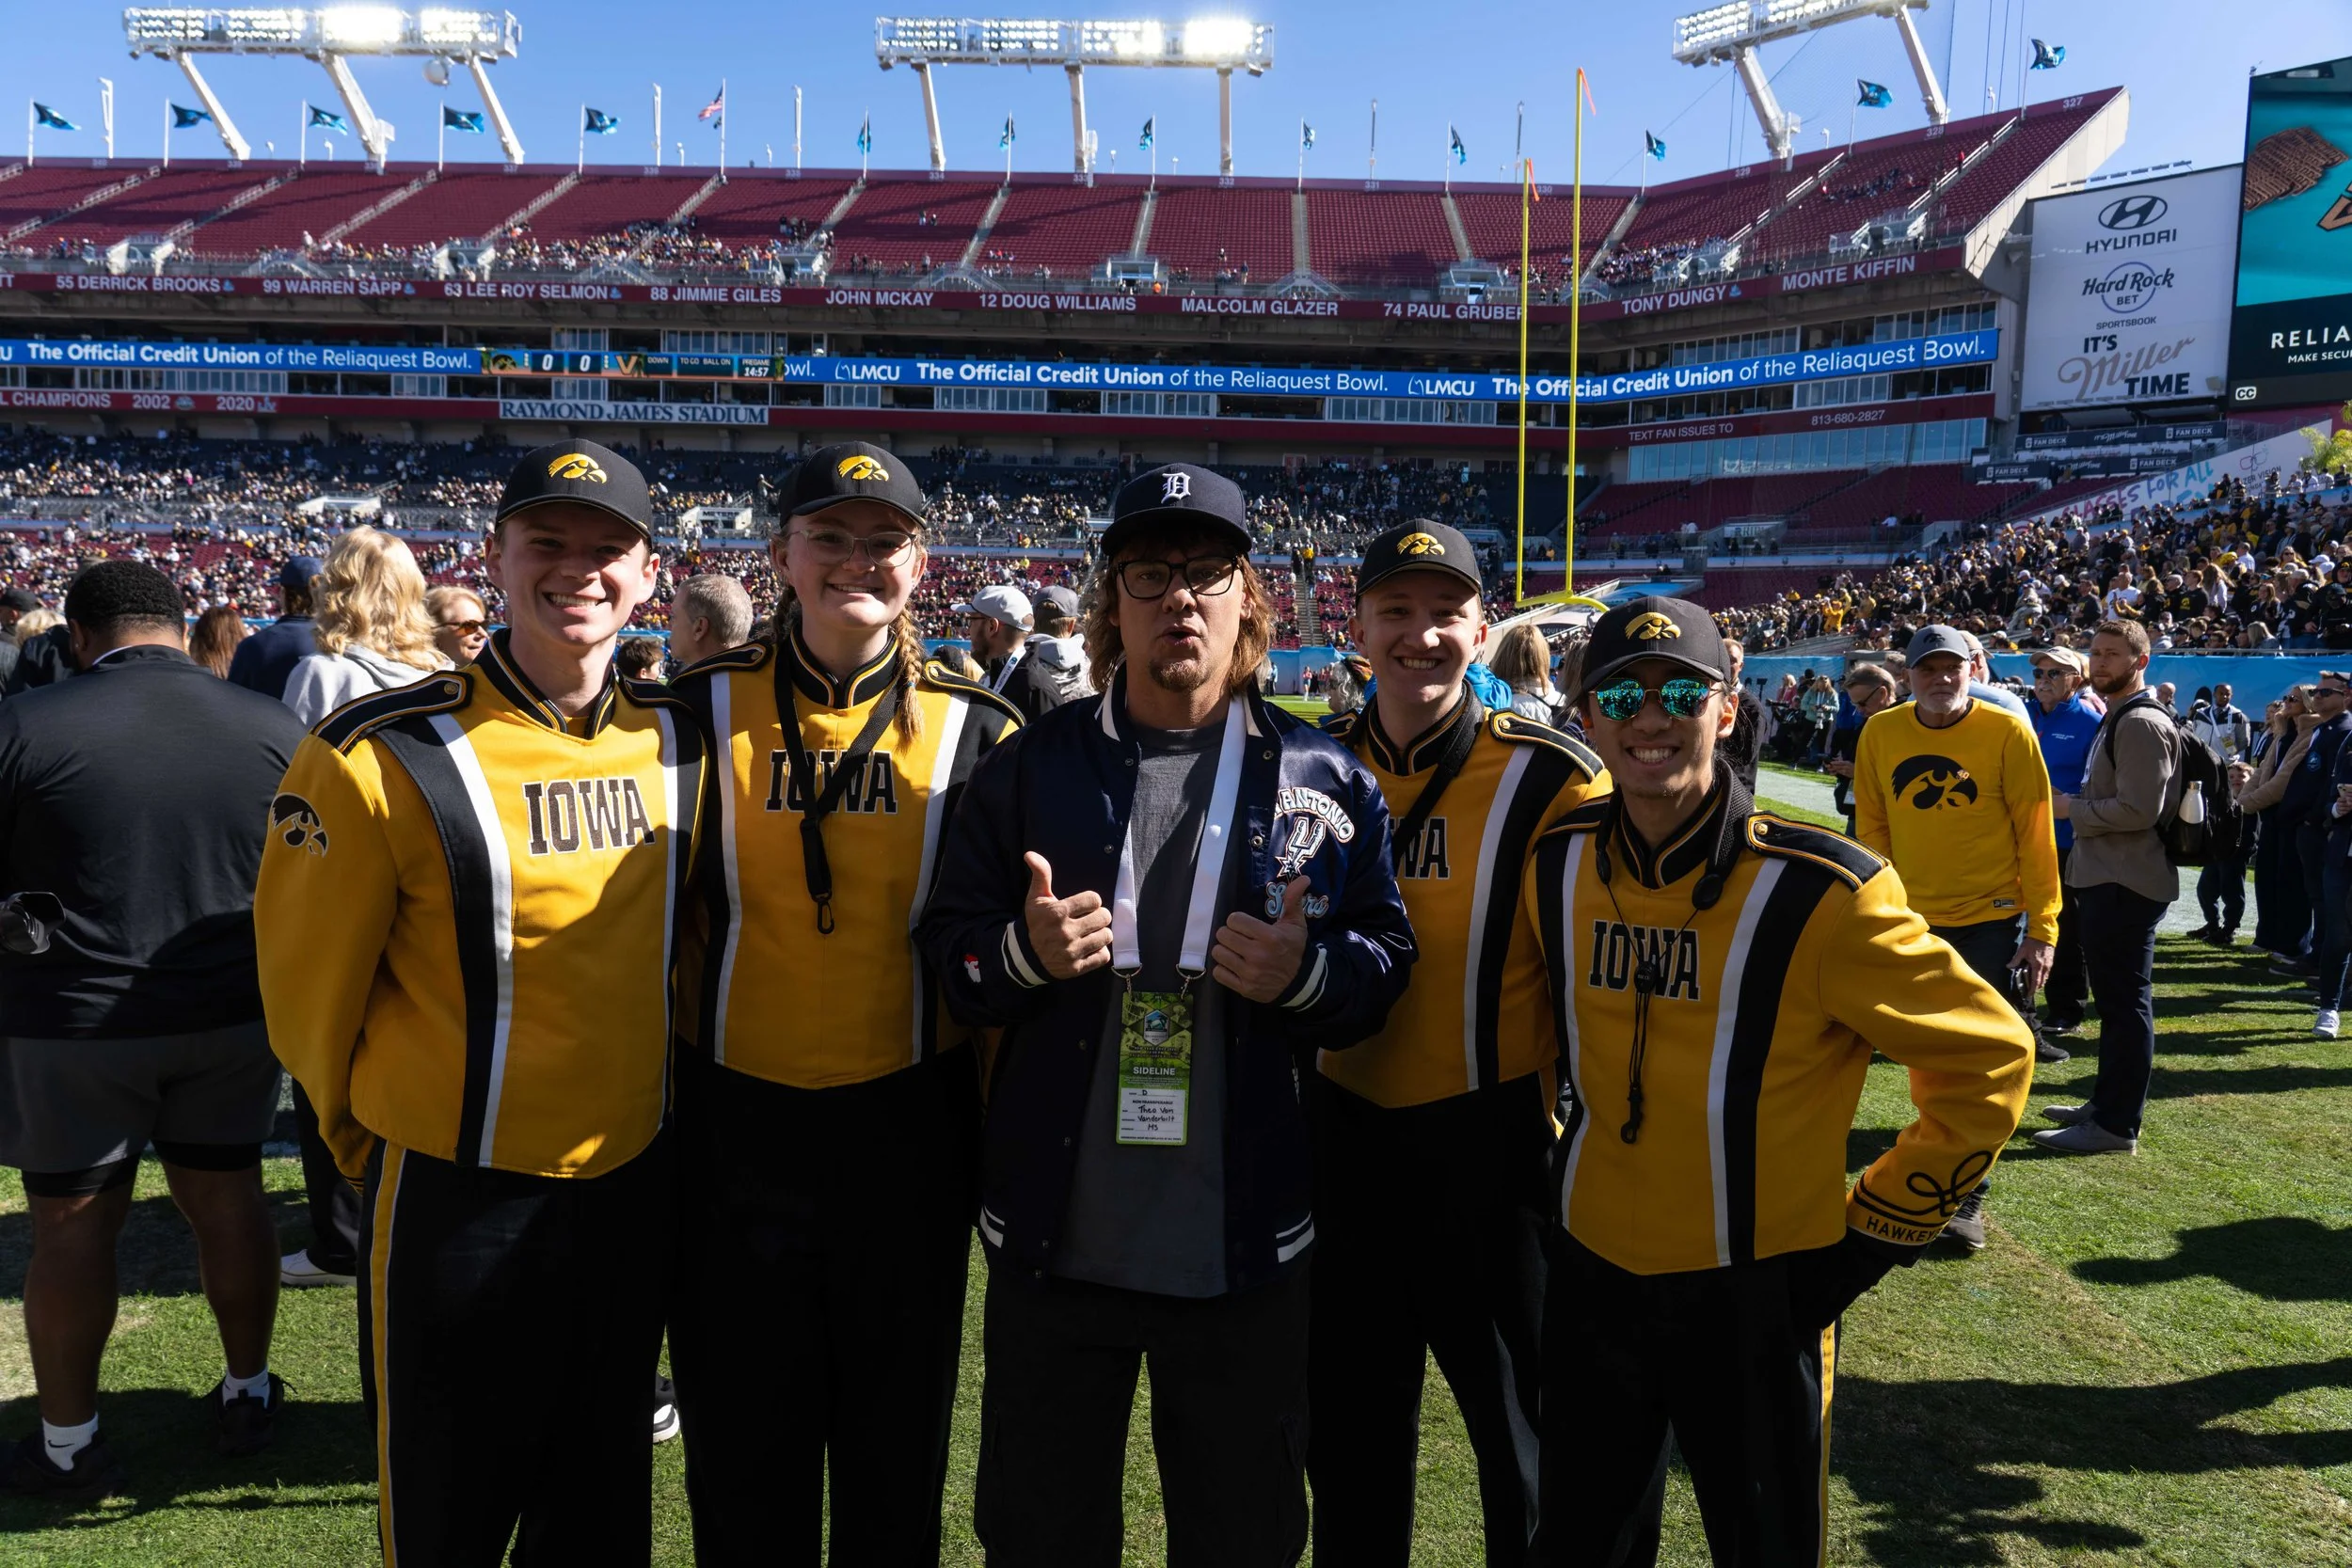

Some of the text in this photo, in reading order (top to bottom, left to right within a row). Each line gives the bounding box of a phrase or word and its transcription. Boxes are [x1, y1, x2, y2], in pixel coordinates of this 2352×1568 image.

[2062, 96, 2084, 109] 327
[1926, 126, 1945, 137] 328
[1218, 177, 1235, 186] 332
[1364, 180, 1380, 189] 331
[2086, 229, 2177, 254] HYUNDAI
[1782, 255, 1915, 291] MONTE KIFFIN
[2082, 268, 2175, 295] Hard Rock
[56, 276, 220, 293] 55 DERRICK BROOKS
[263, 279, 402, 295] 99 WARREN SAPP
[444, 283, 608, 299] 63 LEE ROY SELMON
[650, 287, 782, 303] 88 JIMMIE GILES
[826, 290, 934, 307] JOHN MCKAY
[979, 293, 1136, 311] 12 DOUG WILLIAMS
[1622, 285, 1726, 314] TONY DUNGY
[2117, 294, 2139, 306] BET
[1182, 298, 1338, 316] MALCOLM GLAZER
[1384, 303, 1402, 317] 74
[1407, 304, 1451, 318] PAUL
[2096, 316, 2156, 330] SPORTSBOOK
[2084, 335, 2118, 354] IT'S
[2270, 325, 2351, 349] RELIA
[27, 343, 472, 371] The Official Credit Union of the Reliaquest Bowl.
[542, 354, 591, 372] 0 0
[851, 364, 900, 380] LMCU
[916, 363, 953, 380] The
[960, 364, 1030, 382] Official
[1036, 365, 1099, 384] Credit
[1104, 367, 1164, 386] Union
[1170, 370, 1189, 386] of
[1195, 370, 1224, 387] the
[1232, 371, 1330, 391] Reliaquest
[1337, 373, 1388, 391] Bowl.
[1425, 380, 1475, 396] LMCU
[1613, 372, 1669, 395] Credit
[1675, 367, 1733, 388] Union
[1740, 361, 1759, 381] of
[1765, 359, 1796, 378] the
[1804, 344, 1915, 373] Reliaquest
[1923, 335, 1985, 360] Bowl.
[2288, 353, 2318, 364] MAKE
[2058, 336, 2196, 401] Miller
[2124, 372, 2190, 396] TIME
[12, 391, 111, 407] CHAMPIONS
[133, 394, 170, 409] 2002
[2236, 388, 2255, 399] CC
[216, 396, 255, 411] 2020
[501, 402, 767, 423] RAYMOND JAMES STADIUM
[1811, 409, 1885, 426] 813-680-2827
[1629, 423, 1734, 441] TEXT FAN ISSUES TO
[2155, 458, 2177, 467] DECK
[1161, 471, 1191, 504] D
[2147, 470, 2179, 499] FOR
[2185, 461, 2214, 487] ALL
[765, 749, 898, 814] IOWA
[522, 776, 656, 857] IOWA
[1278, 787, 1355, 844] ANTONIO
[1588, 918, 1701, 1002] IOWA
[1133, 1066, 1176, 1076] SIDELINE
[1138, 1104, 1157, 1114] Theo
[1866, 1215, 1941, 1243] HAWKEY
